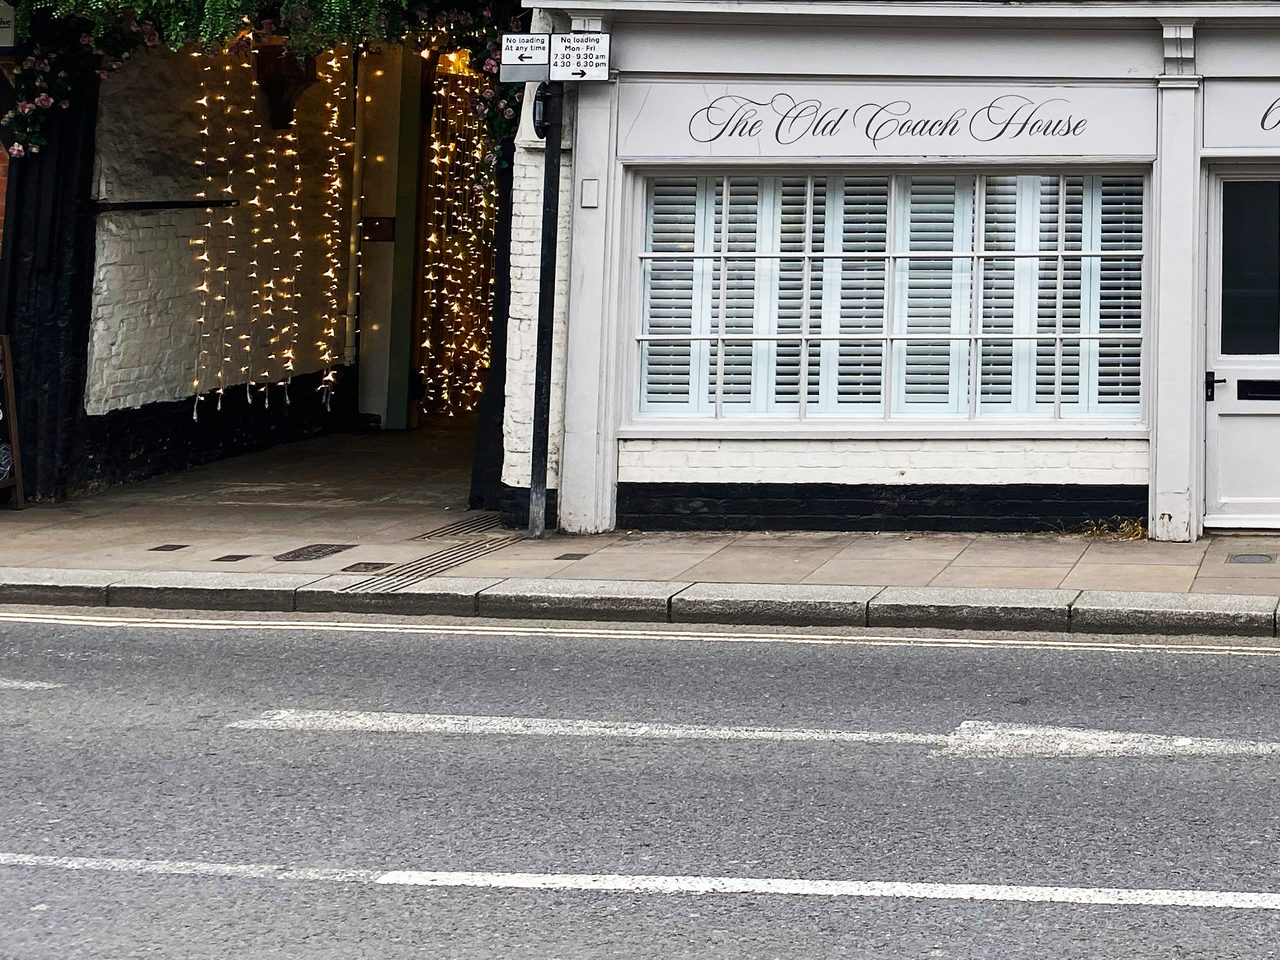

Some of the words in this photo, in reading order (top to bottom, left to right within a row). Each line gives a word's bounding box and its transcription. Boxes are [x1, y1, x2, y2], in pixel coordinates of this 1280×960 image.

[519, 37, 545, 45] loading
[560, 36, 571, 44] No
[573, 36, 600, 44] loading
[688, 95, 773, 143] The
[771, 92, 849, 145] Old
[853, 100, 967, 151] Coach
[969, 94, 1088, 142] House
